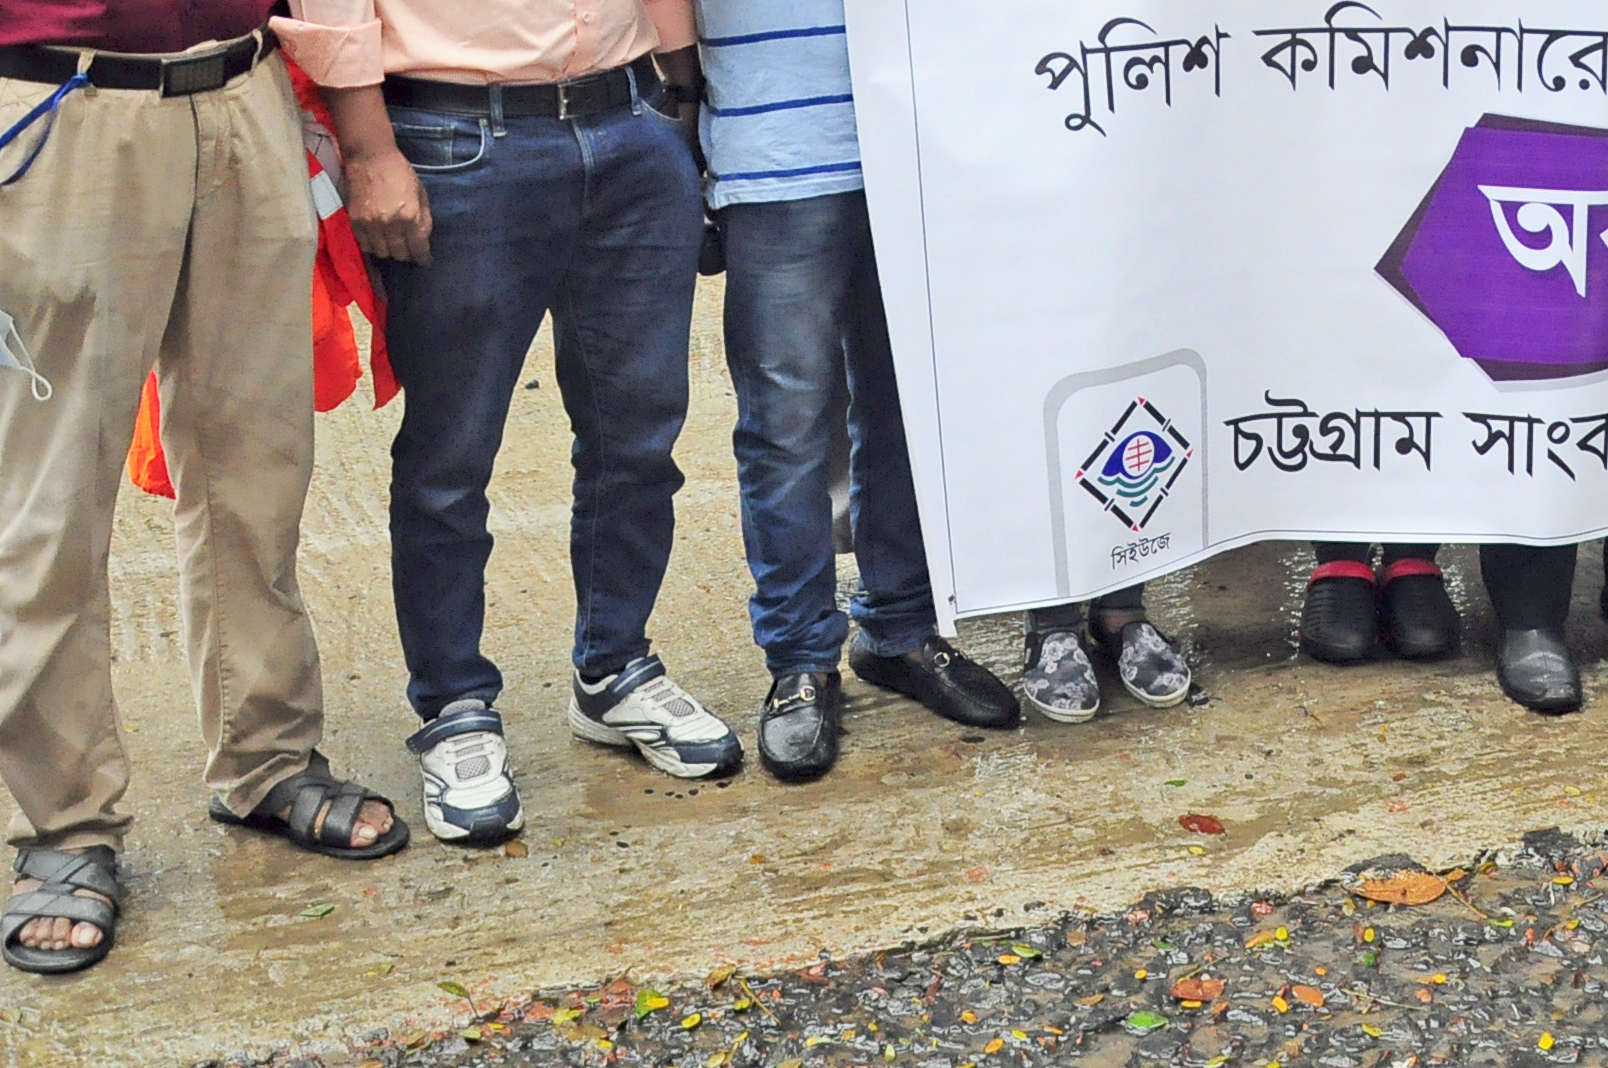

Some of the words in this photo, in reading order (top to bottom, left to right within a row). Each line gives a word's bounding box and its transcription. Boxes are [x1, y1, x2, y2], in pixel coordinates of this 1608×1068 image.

[1034, 17, 1231, 137] পুলিশ
[1223, 389, 1443, 473] চট্টগ্রাম
[1110, 532, 1172, 571] সিইউজে
